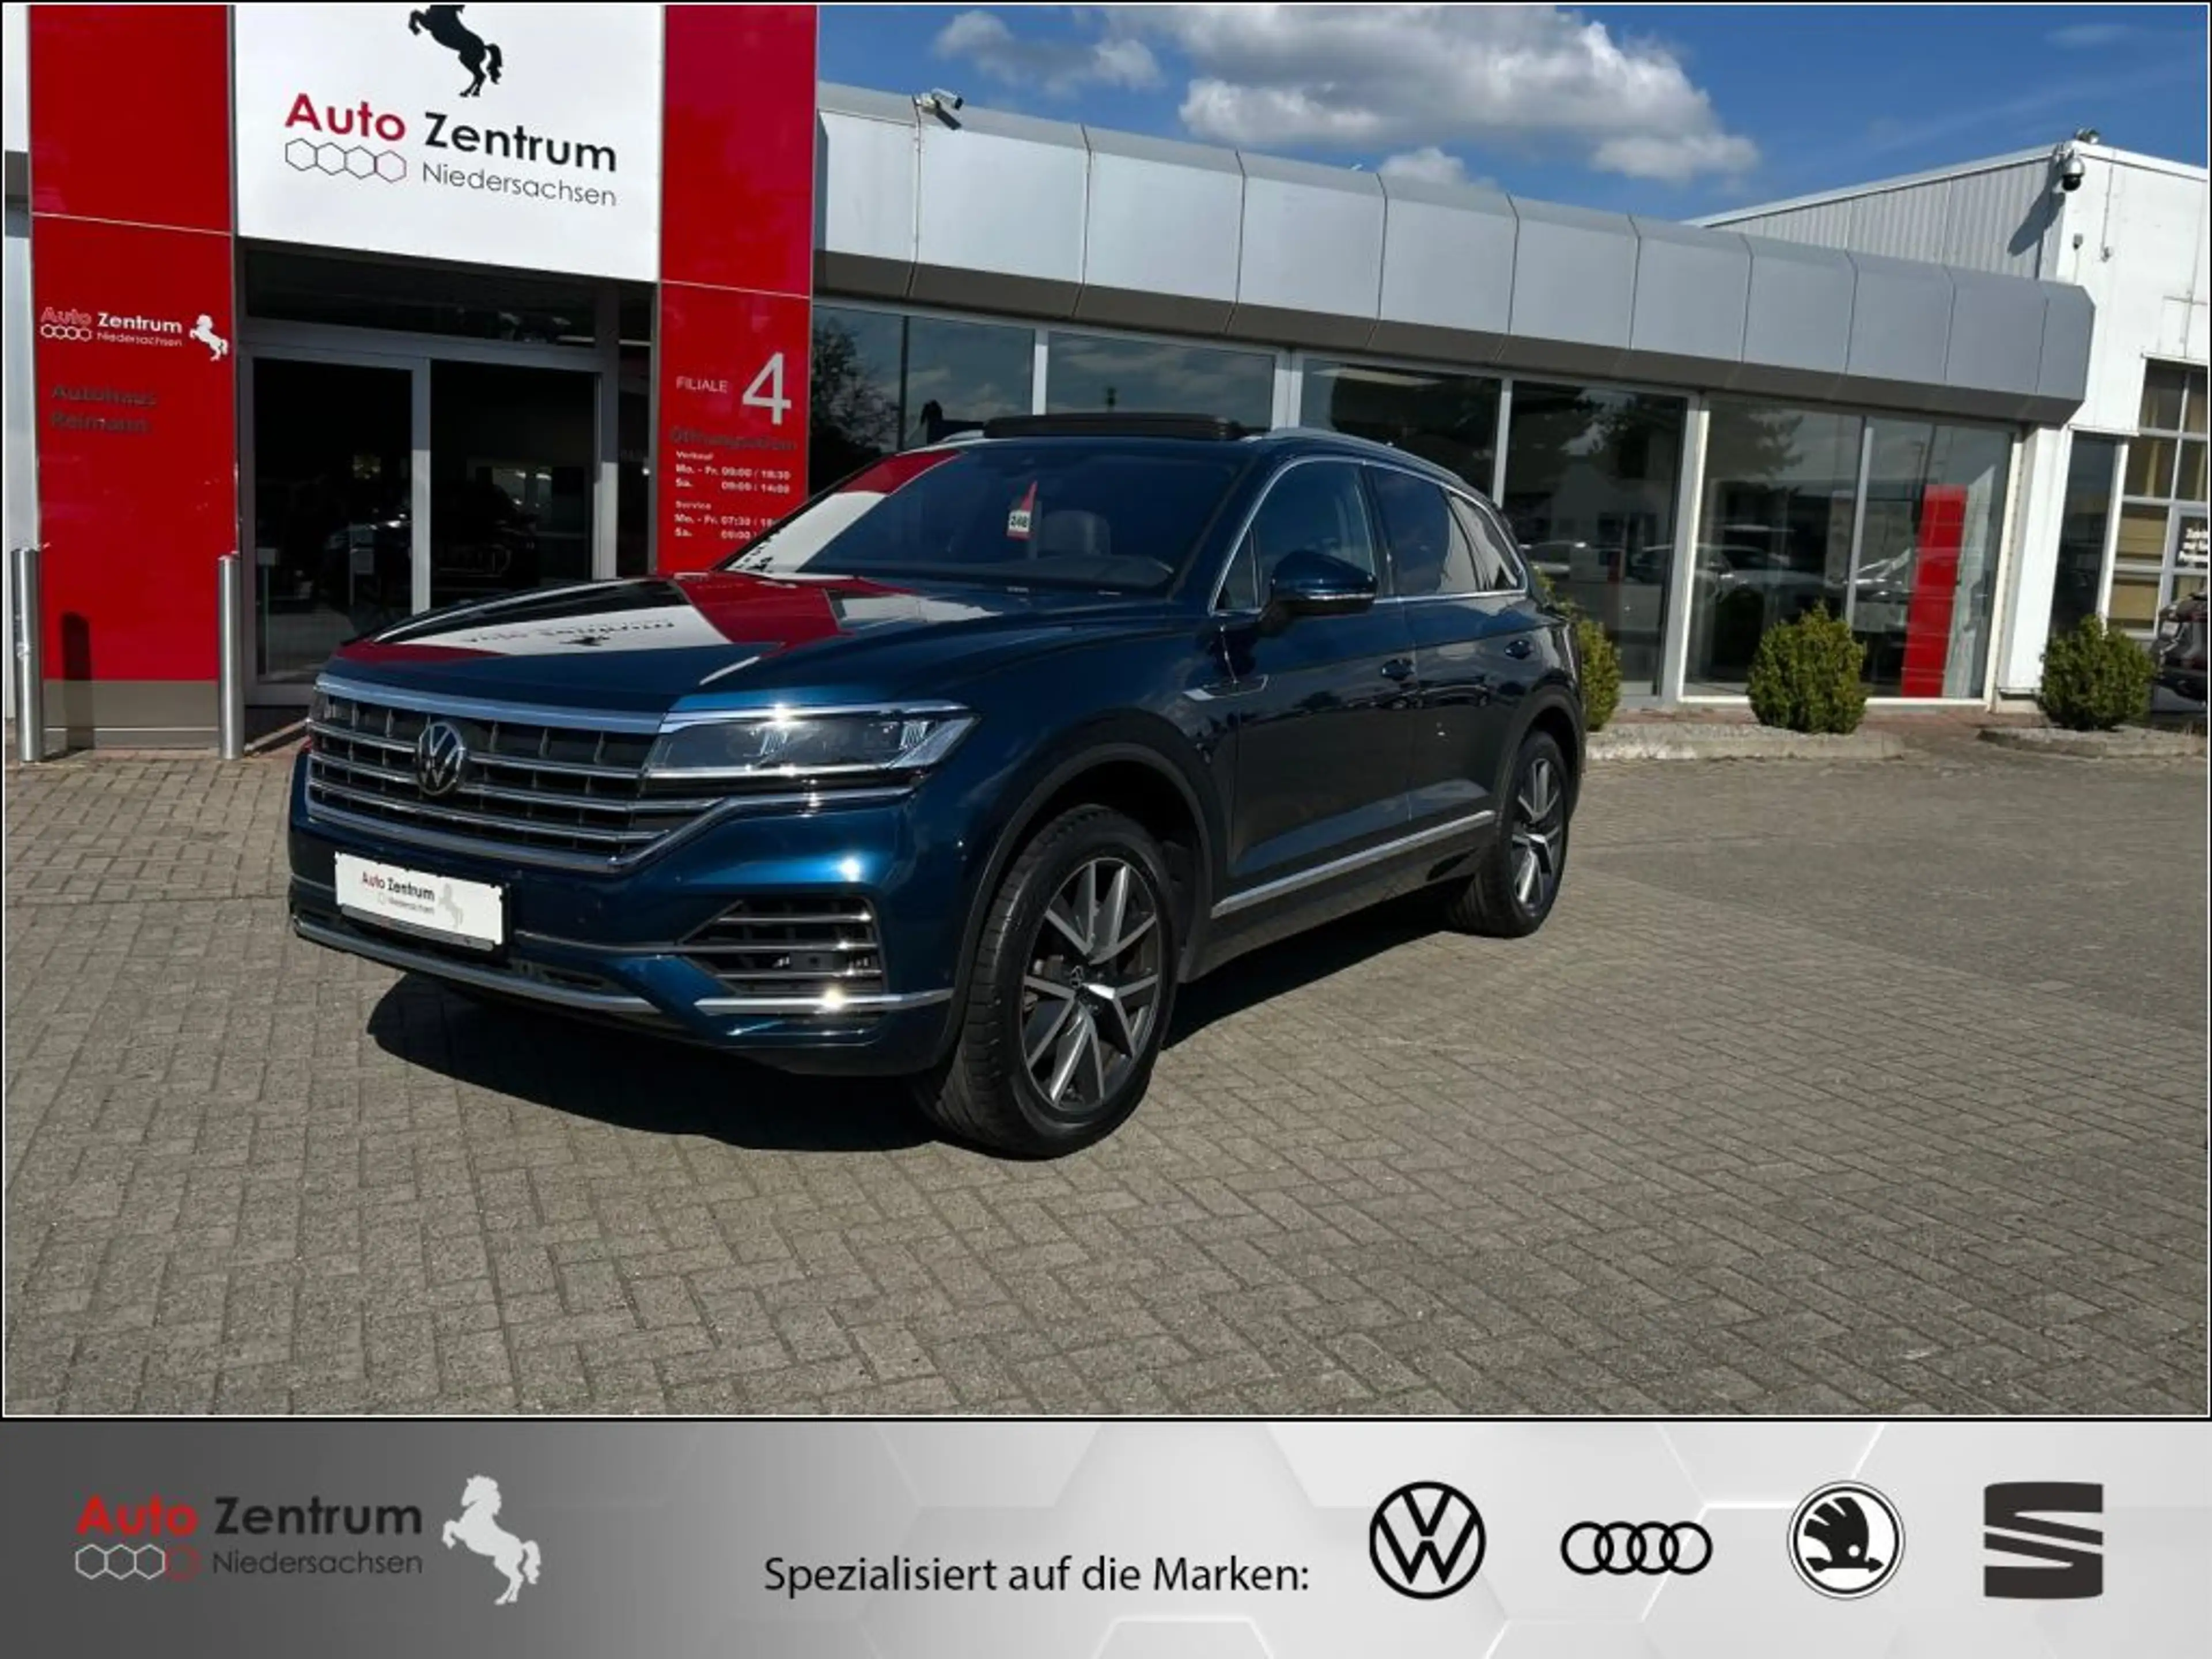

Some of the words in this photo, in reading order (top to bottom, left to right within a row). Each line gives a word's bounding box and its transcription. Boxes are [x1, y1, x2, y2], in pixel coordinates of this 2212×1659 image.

[285, 93, 406, 142] Auto
[424, 111, 617, 172] Zentrum
[422, 161, 616, 206] Niedersachsen
[41, 307, 92, 325] Auto
[97, 312, 183, 334] Zentrum
[676, 376, 728, 393] FILIALE
[743, 351, 791, 425] 4
[675, 464, 695, 474] Mo.
